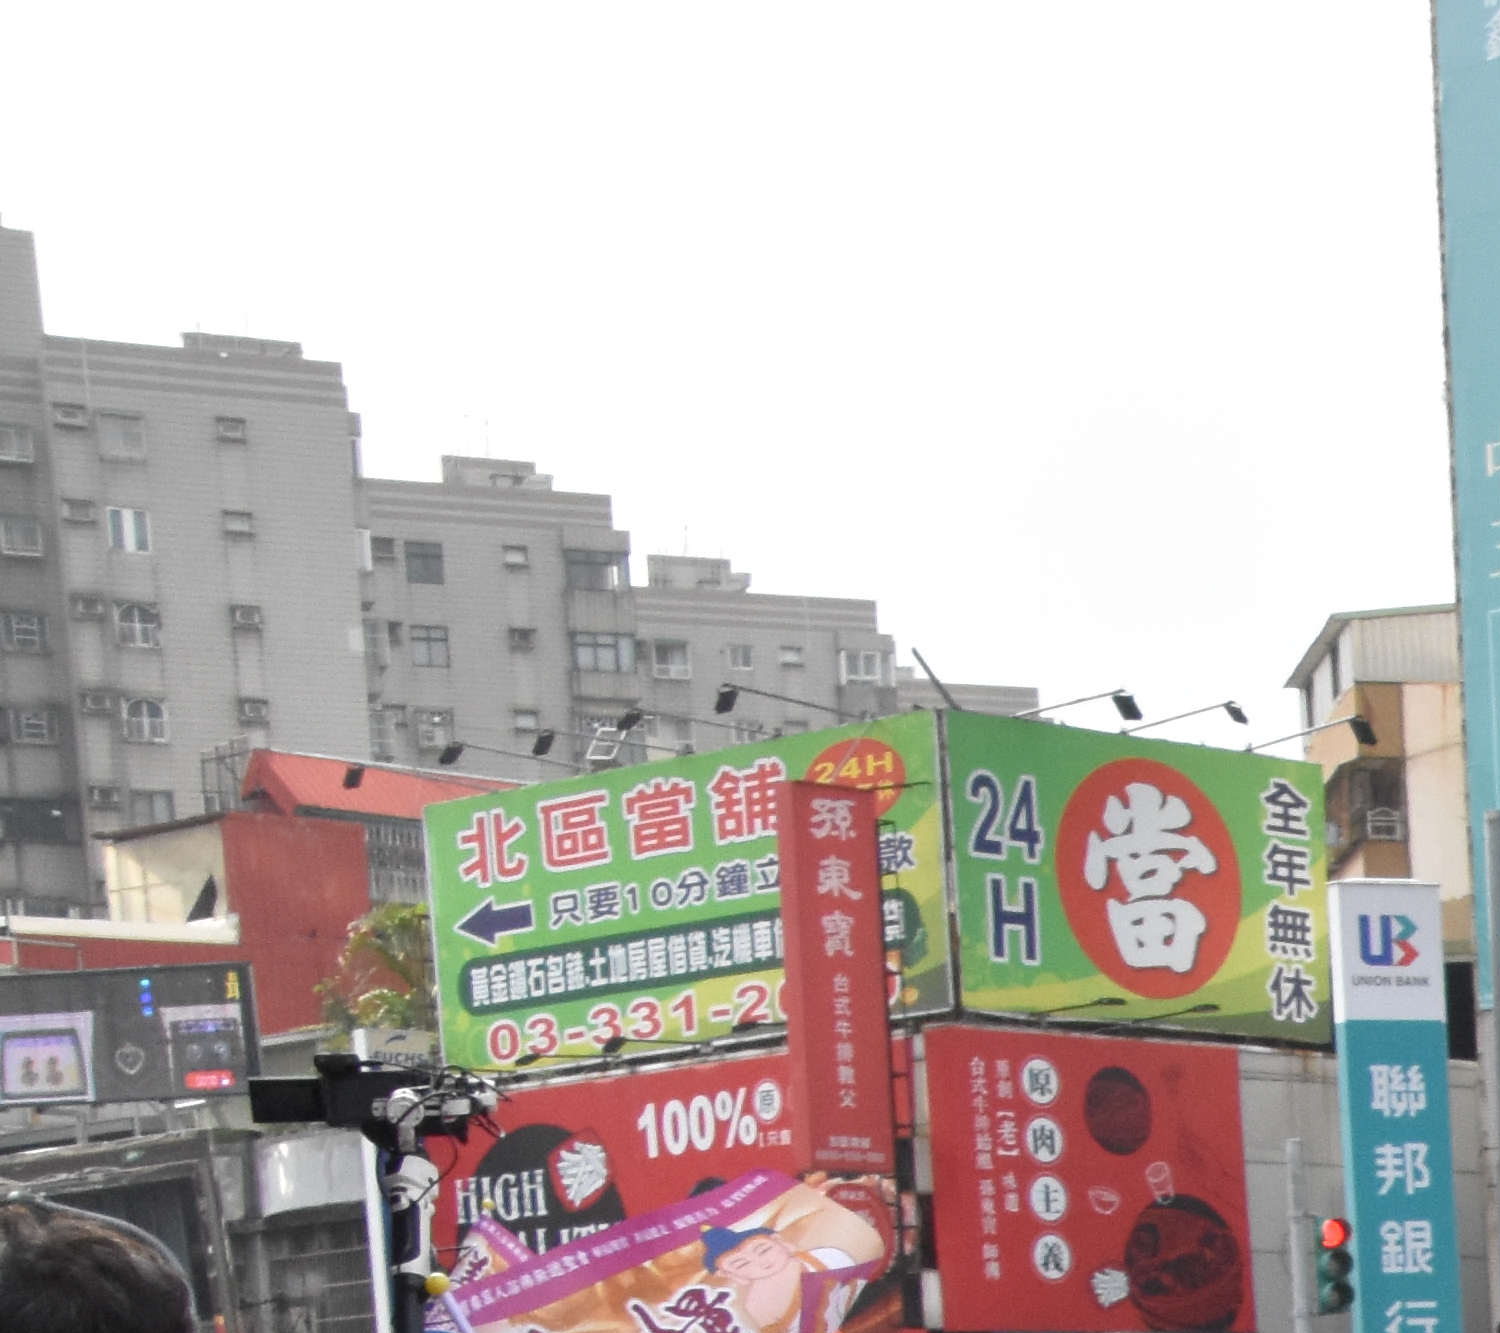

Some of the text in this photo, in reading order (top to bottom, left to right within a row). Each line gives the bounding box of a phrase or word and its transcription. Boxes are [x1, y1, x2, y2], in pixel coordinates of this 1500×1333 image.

[967, 770, 1042, 862] 24
[989, 875, 1041, 966] H
[1083, 781, 1218, 973] 當
[1261, 778, 1318, 1023] 全年無休
[1350, 974, 1431, 988] UNION BANK
[636, 1086, 760, 1158] 100%
[454, 1167, 548, 1224] HIGH
